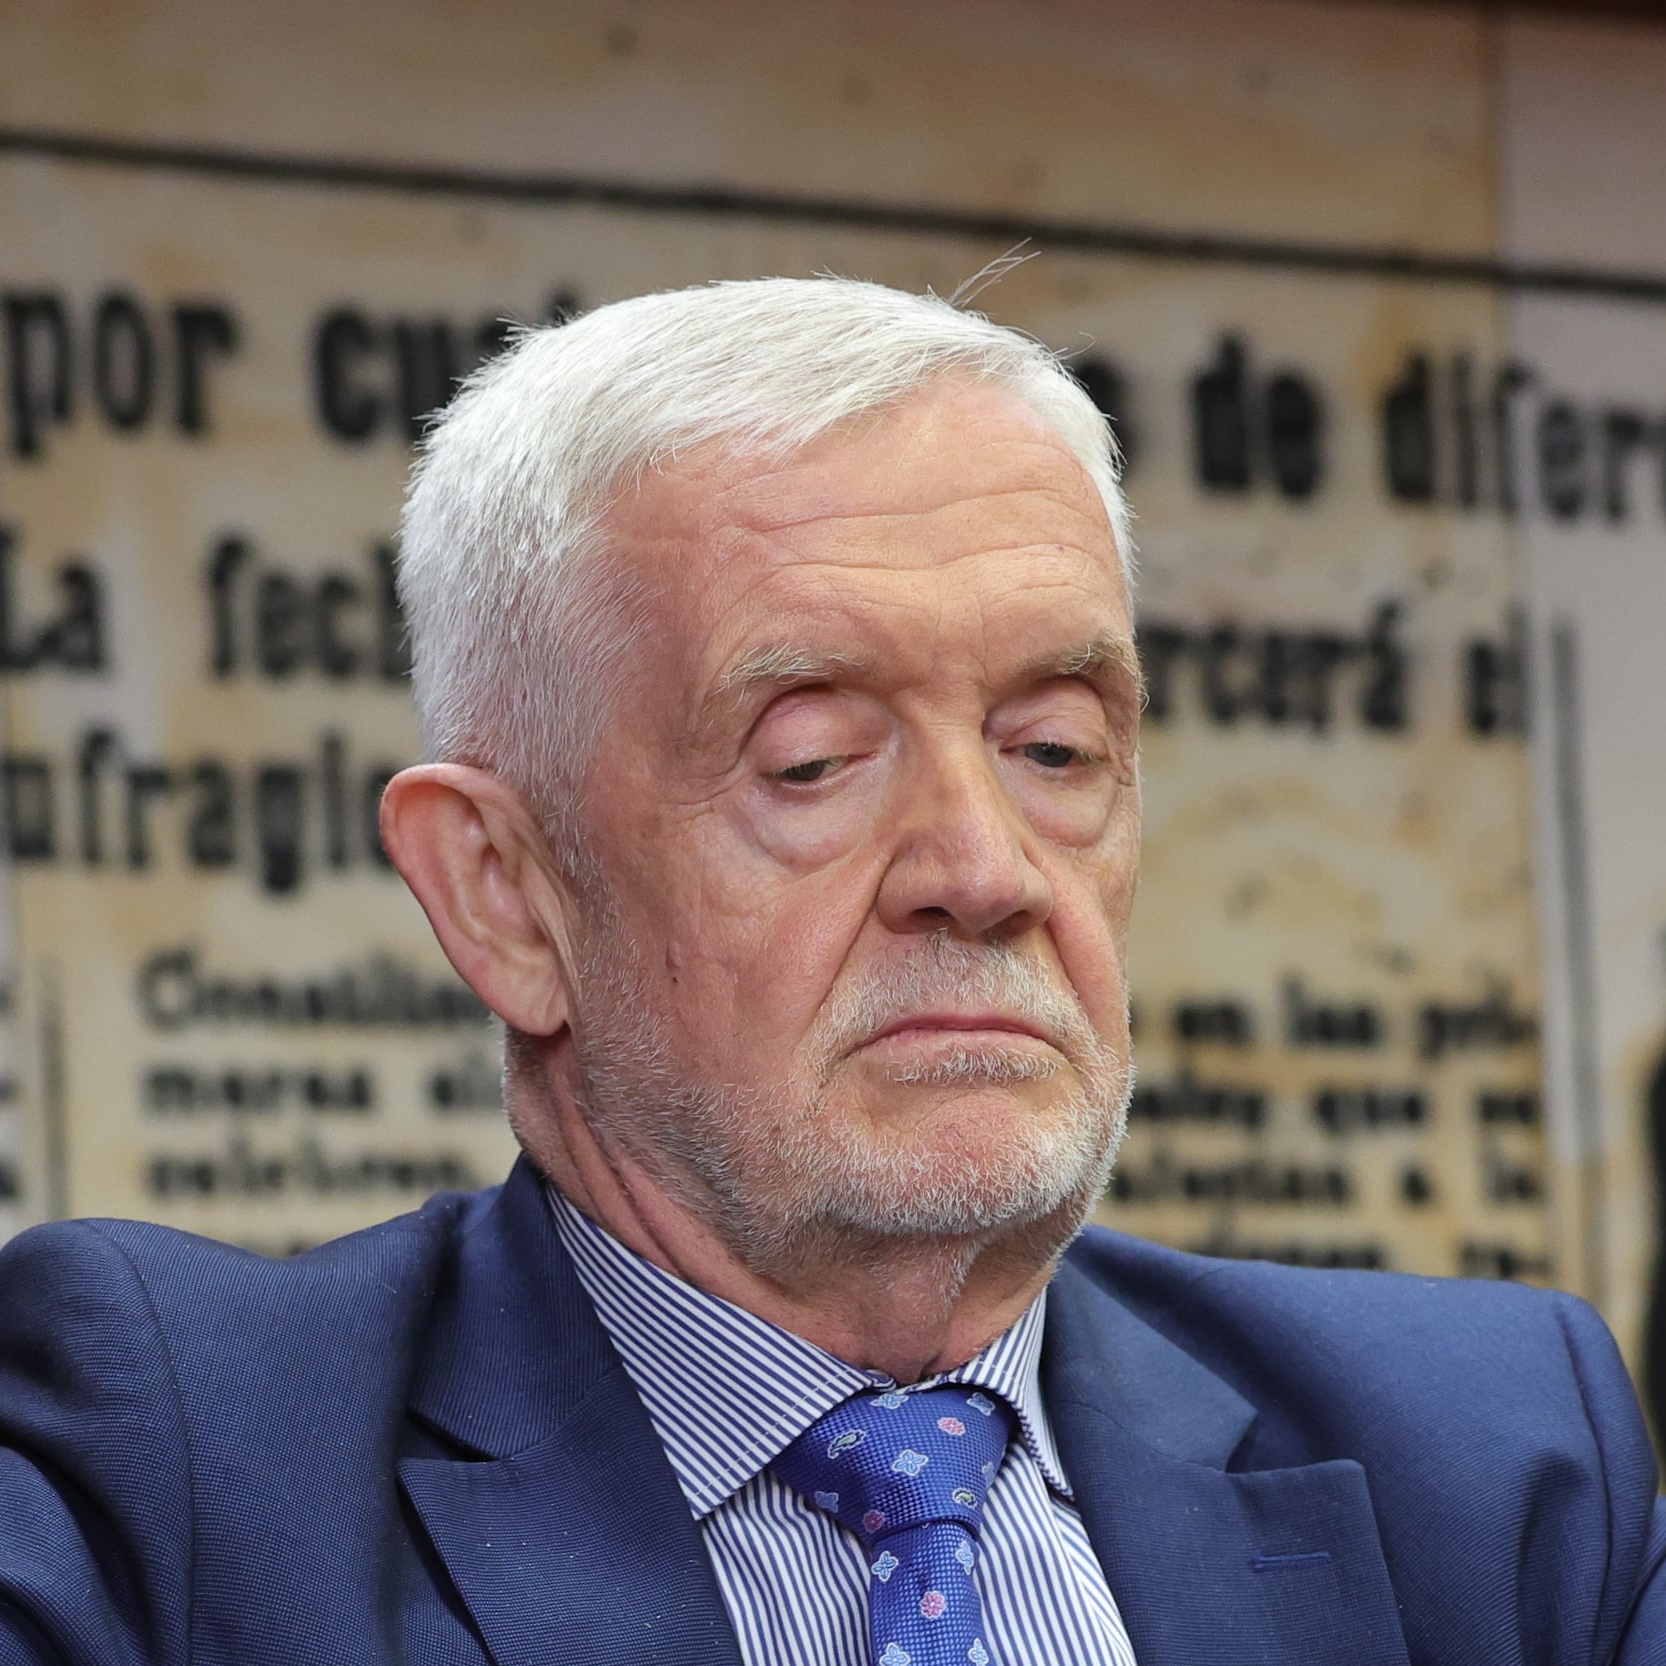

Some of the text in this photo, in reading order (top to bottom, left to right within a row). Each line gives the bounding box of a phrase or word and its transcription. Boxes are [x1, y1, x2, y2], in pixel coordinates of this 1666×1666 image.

[1189, 330, 1325, 502] de
[206, 526, 415, 684] fech
[1137, 596, 1407, 736] rcará
